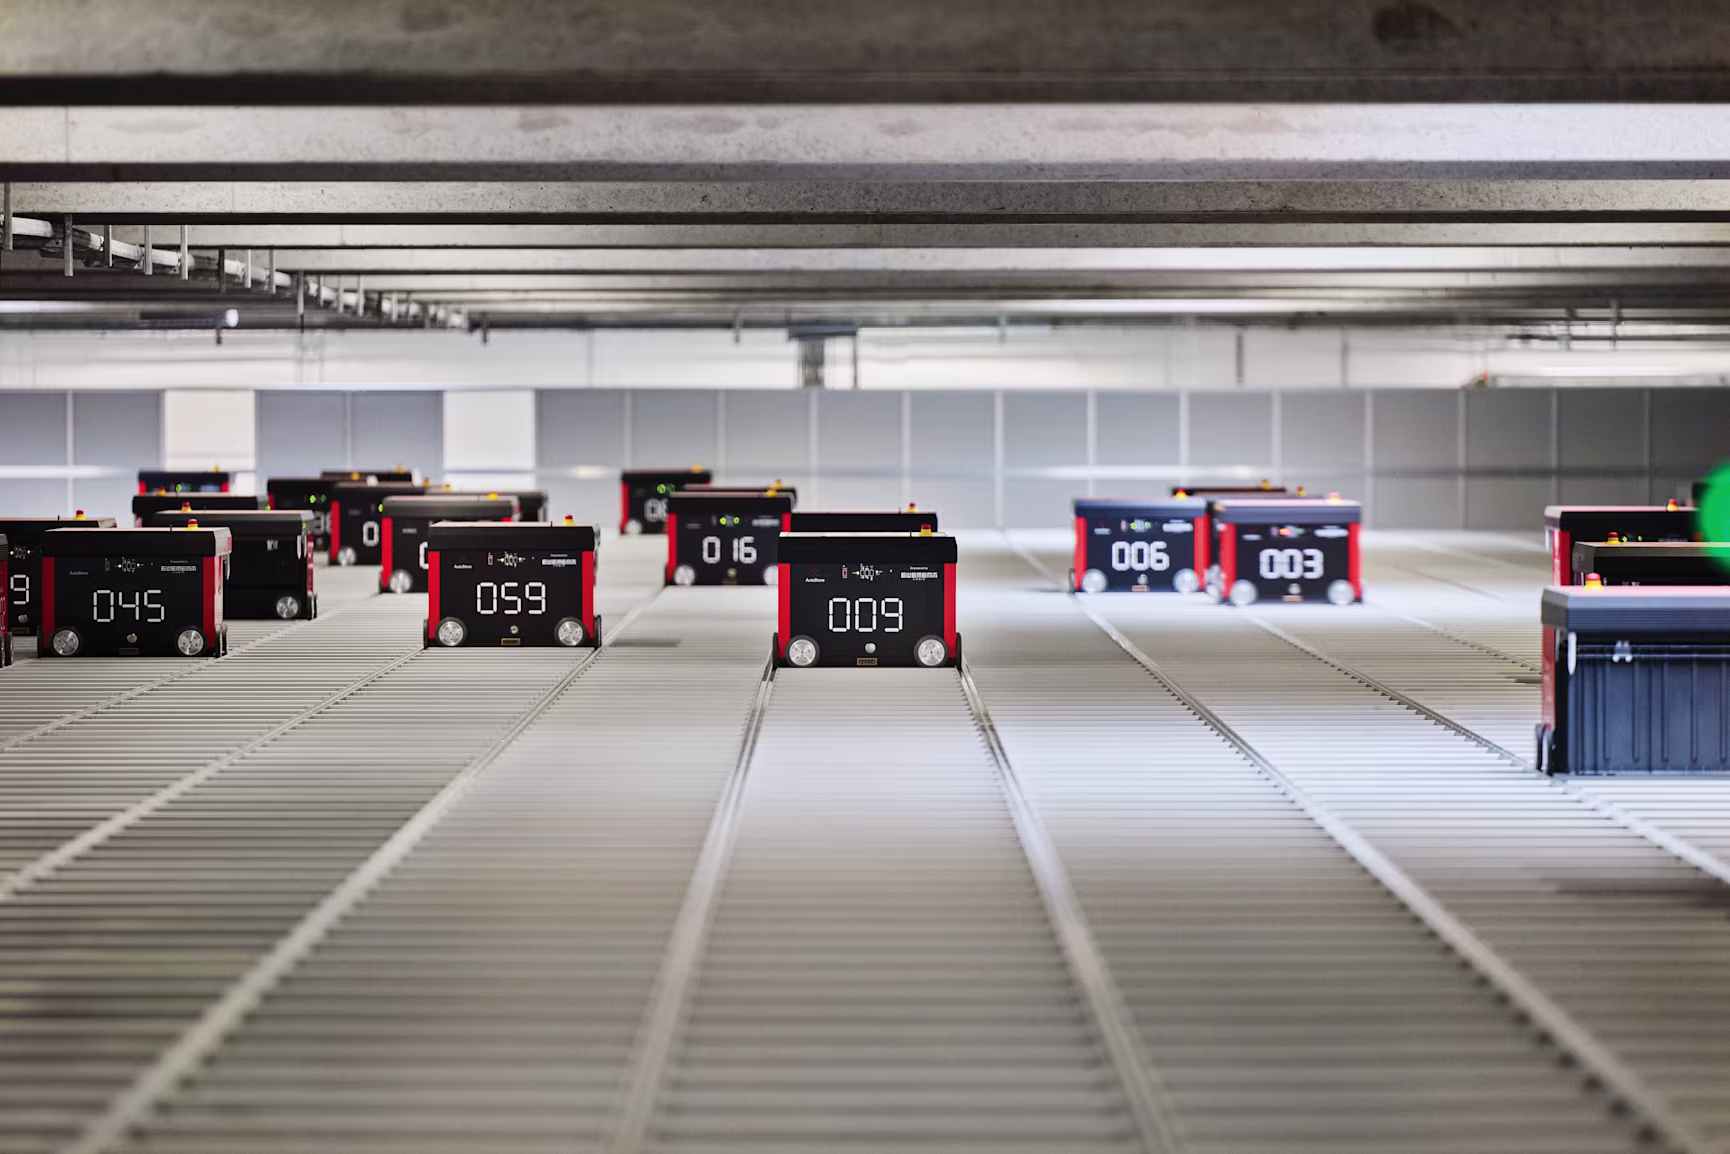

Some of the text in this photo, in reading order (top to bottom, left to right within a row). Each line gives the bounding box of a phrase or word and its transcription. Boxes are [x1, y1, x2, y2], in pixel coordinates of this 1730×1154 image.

[1112, 541, 1170, 571] 006
[1259, 548, 1324, 579] 003
[93, 590, 165, 622] 045
[476, 582, 546, 615] 059
[828, 597, 903, 632] 009
